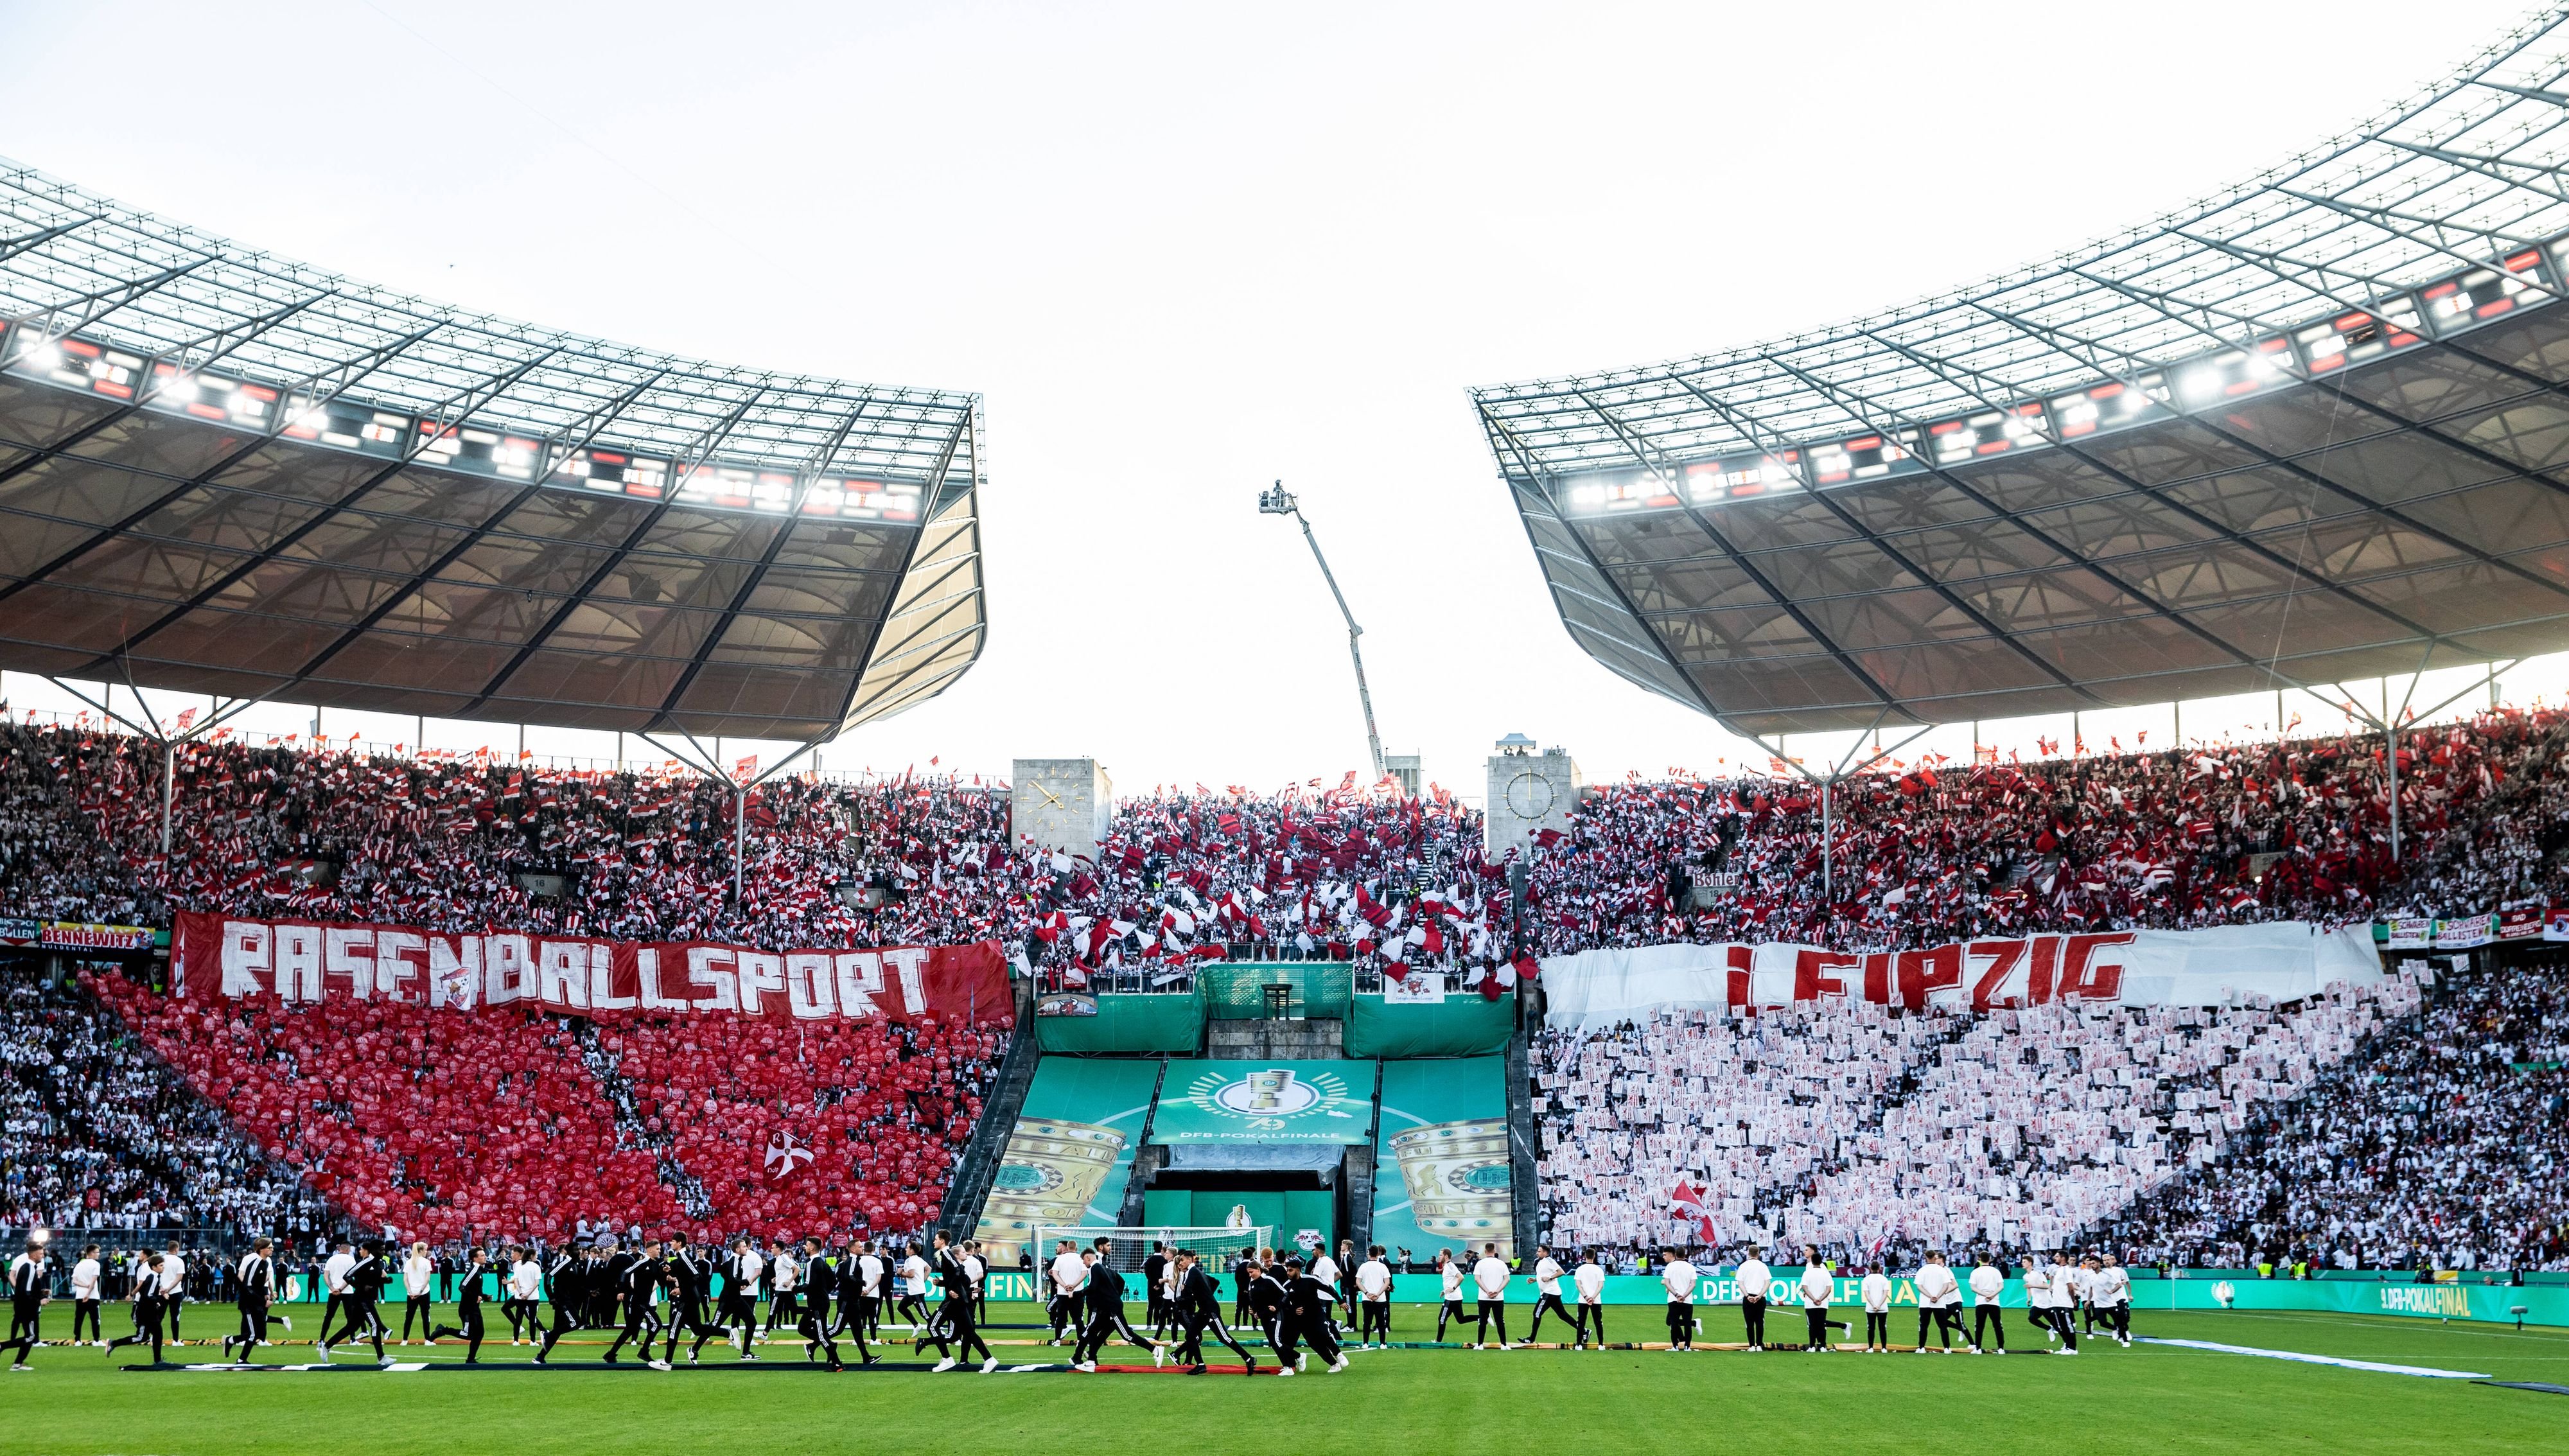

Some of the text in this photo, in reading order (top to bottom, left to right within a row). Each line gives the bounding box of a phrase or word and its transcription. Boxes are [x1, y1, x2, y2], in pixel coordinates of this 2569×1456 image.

[2447, 913, 2491, 931] SCHWABEN
[0, 927, 35, 939] BULLEN
[42, 928, 135, 949] BENNEWITZ
[222, 921, 929, 1019] RASENBALLSPORT
[1245, 1116, 1286, 1130] 79
[2388, 1287, 2471, 1317] DFB-POKALFINAL
